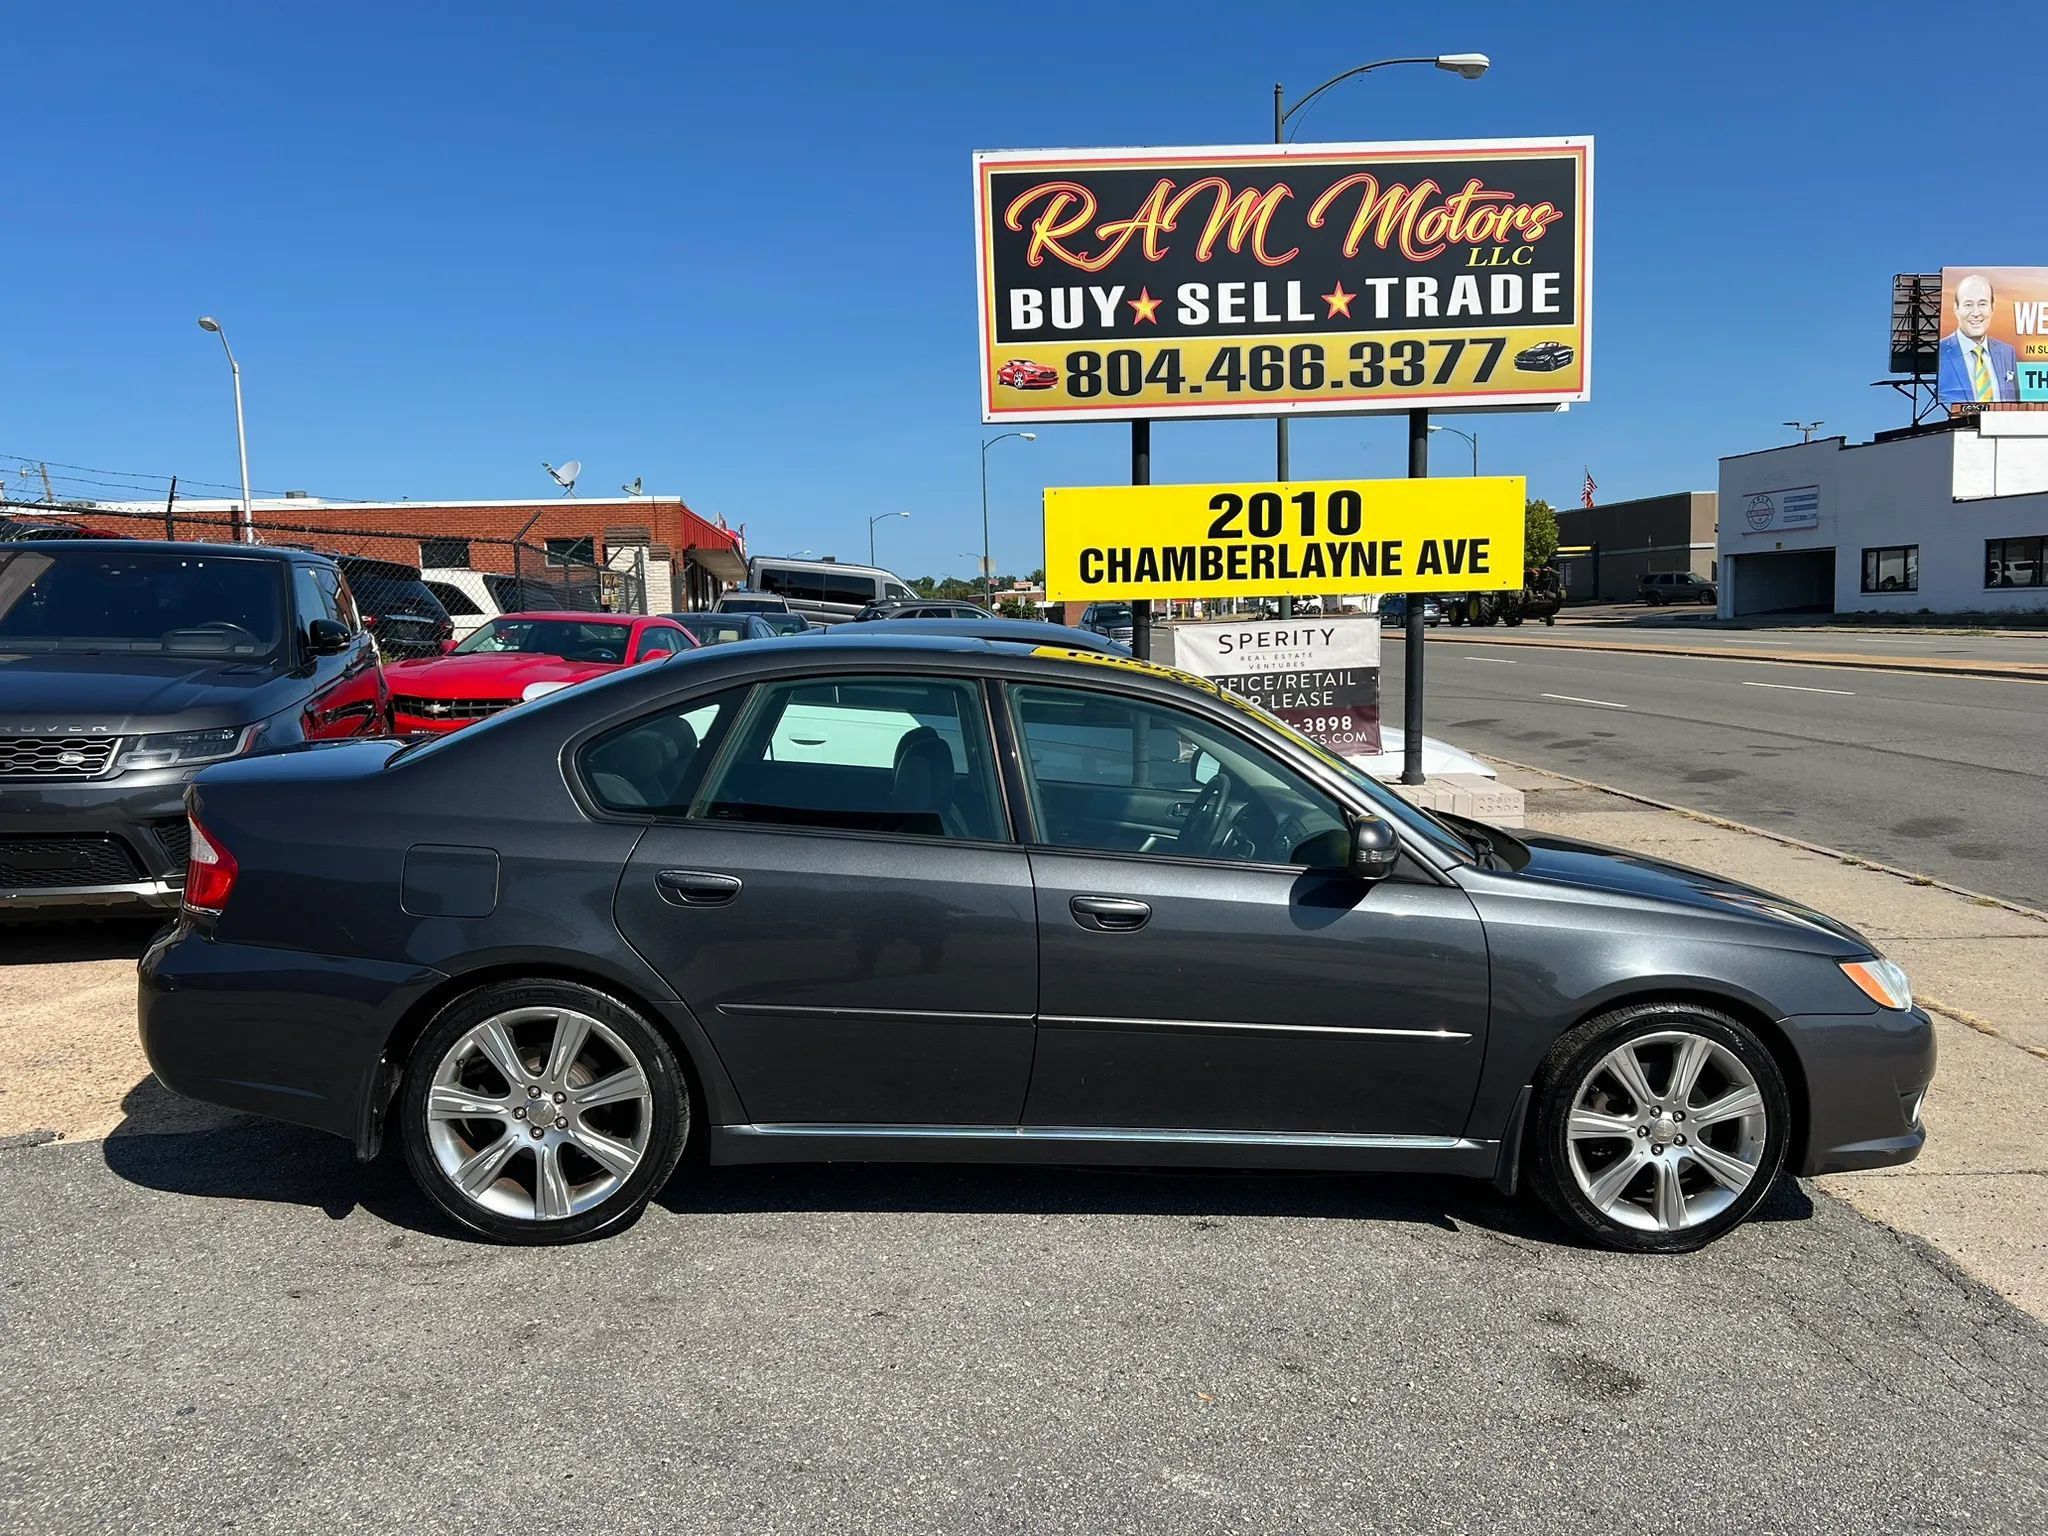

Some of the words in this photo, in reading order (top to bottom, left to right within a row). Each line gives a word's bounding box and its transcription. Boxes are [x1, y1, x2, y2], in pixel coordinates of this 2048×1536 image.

[1005, 174, 1299, 272] RAM
[1307, 172, 1563, 262] Motors
[1466, 245, 1535, 267] LLC
[1009, 285, 1126, 331] BUY
[1177, 279, 1316, 325] SELL
[1365, 272, 1561, 319] TRADE
[2025, 345, 2035, 354] IN
[1065, 337, 1508, 399] 804.466.3377
[1207, 490, 1362, 539] 2010
[1079, 540, 1403, 584] CHAMBERLAYNE
[1416, 538, 1491, 575] AVE
[1218, 628, 1335, 654] SPERITY
[1240, 654, 1267, 662] REAL
[1274, 652, 1313, 660] ESTATE
[1249, 661, 1306, 670] VENTURES
[1215, 671, 1357, 692] FFICE/RETAIL
[1271, 691, 1334, 709] LEASE
